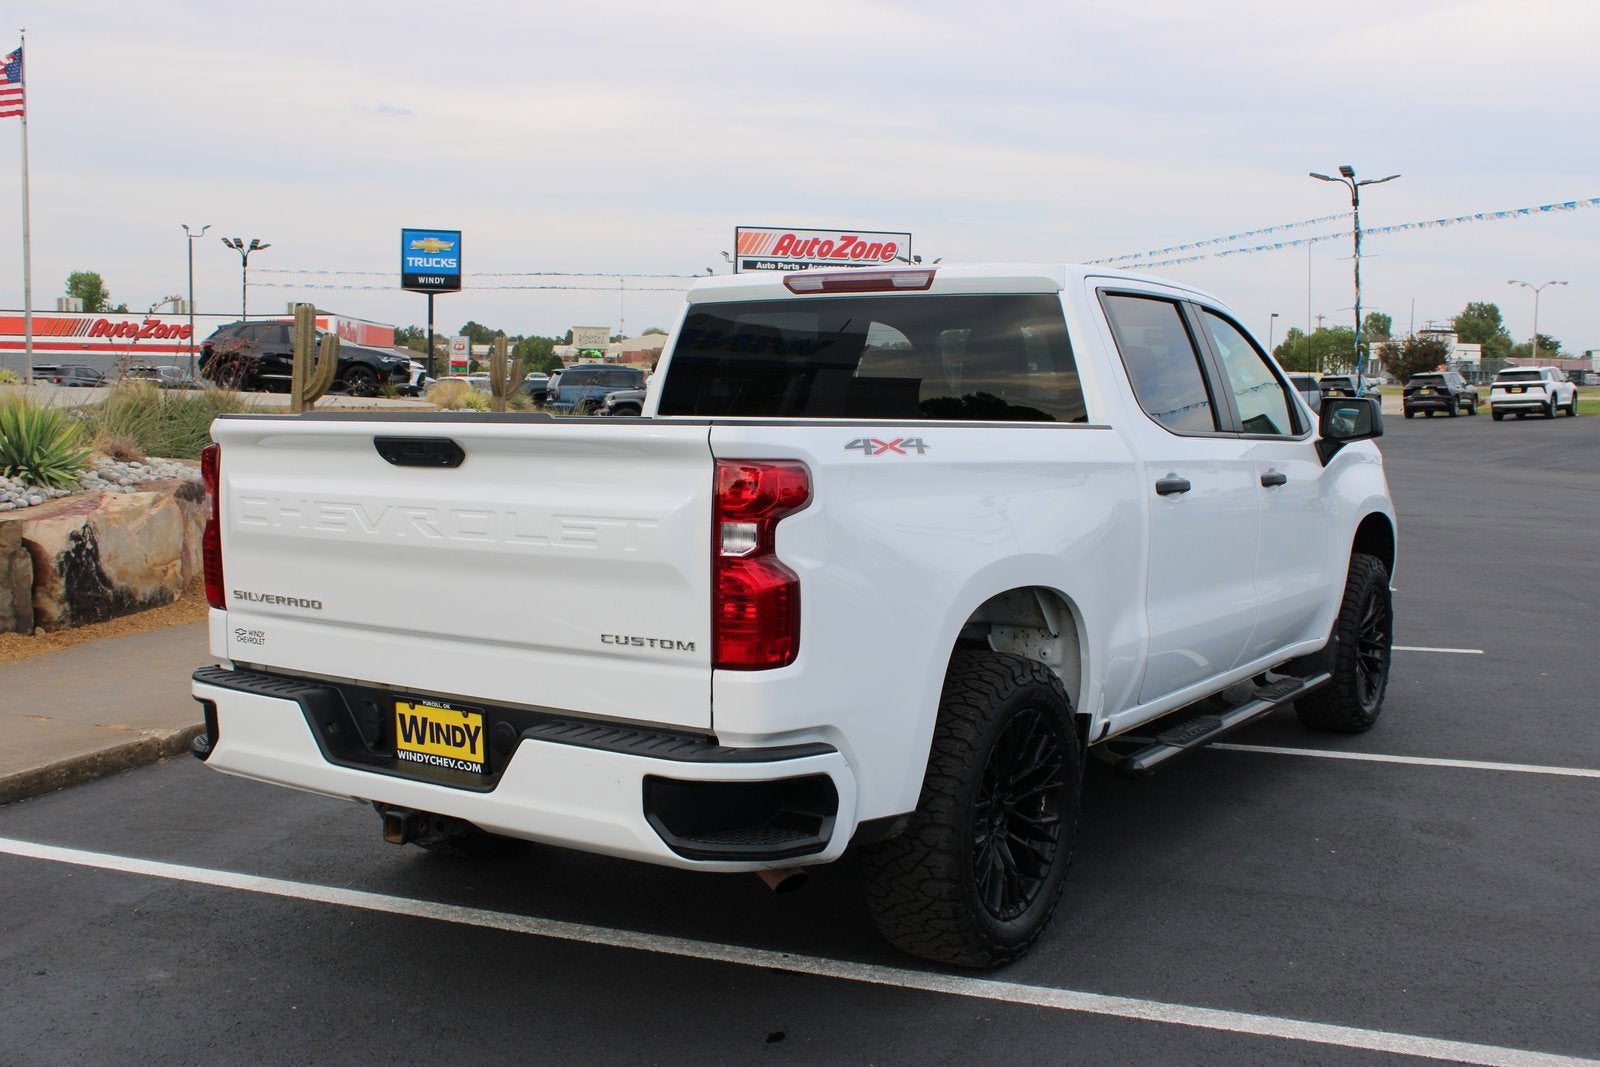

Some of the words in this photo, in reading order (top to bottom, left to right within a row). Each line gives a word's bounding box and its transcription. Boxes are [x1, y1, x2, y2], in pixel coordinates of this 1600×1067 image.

[772, 233, 898, 261] AutoZone
[407, 257, 457, 268] TRUCKS
[88, 318, 192, 339] AutoZone
[239, 496, 659, 551] CHEVROLET
[233, 590, 322, 610] SILVERADO
[236, 636, 265, 645] CHEVROLET
[248, 630, 265, 638] WINDY
[601, 634, 695, 651] CUSTOM
[397, 750, 482, 773] WINDYCHEV.COM
